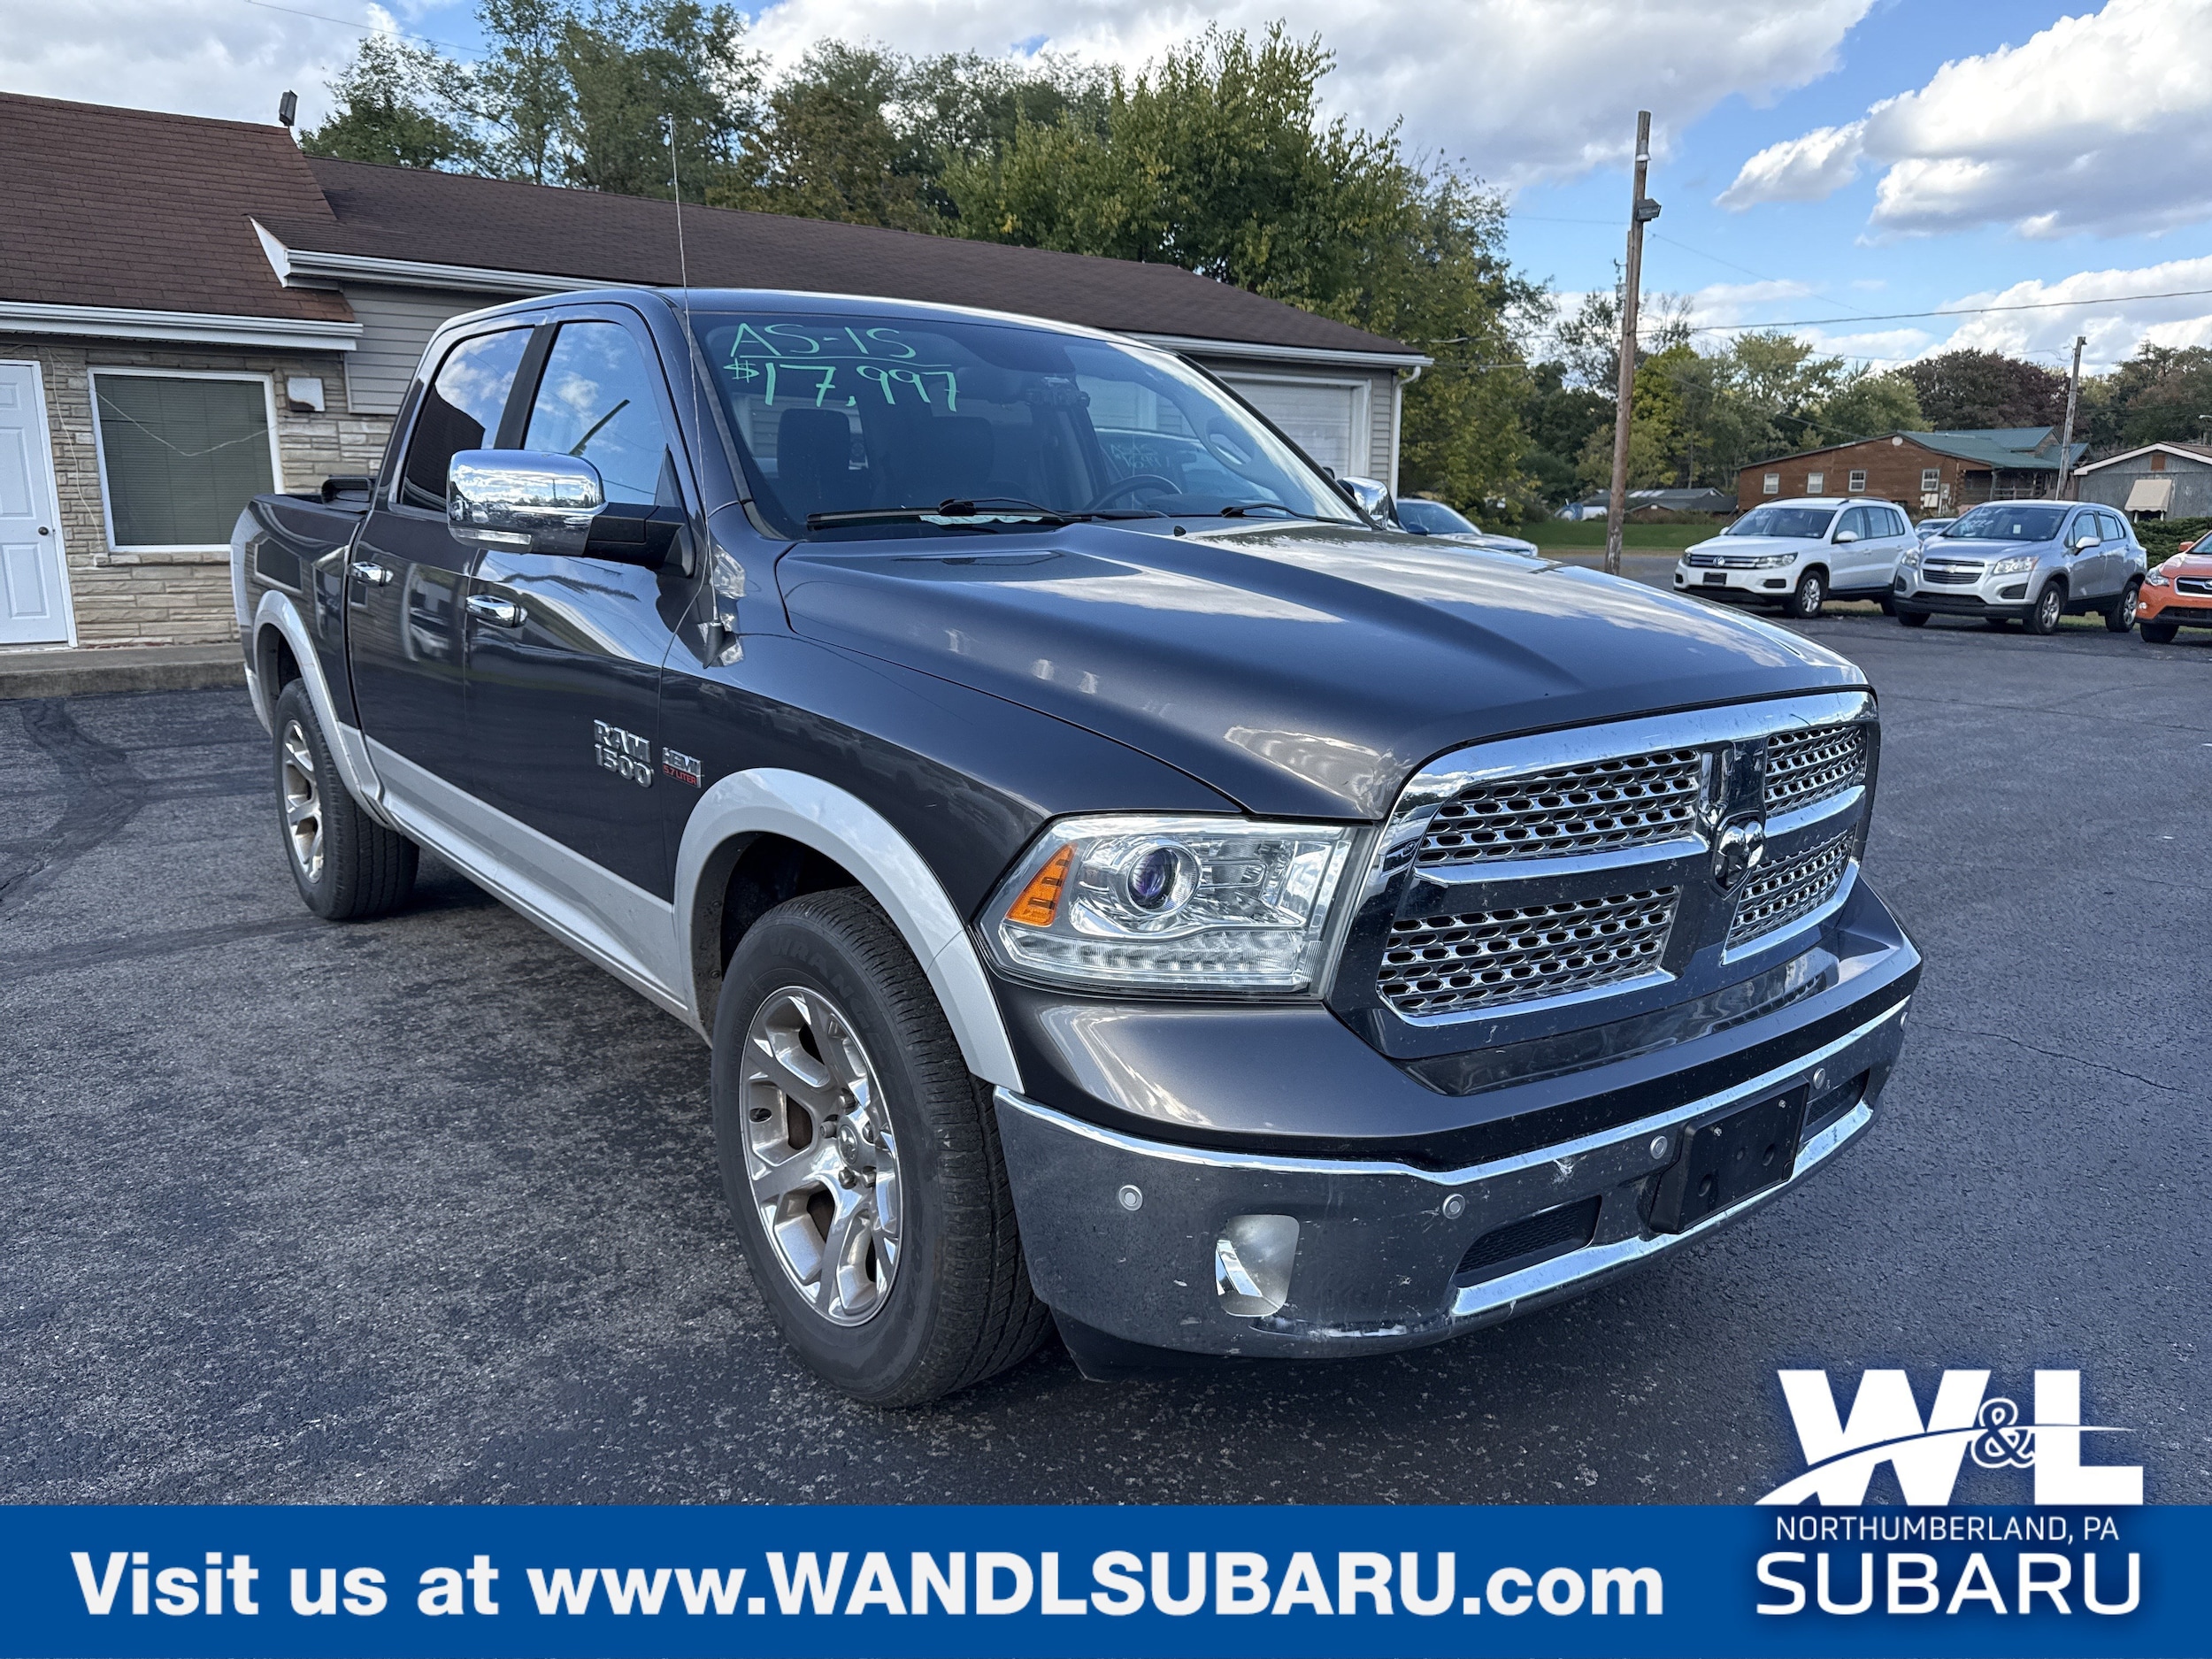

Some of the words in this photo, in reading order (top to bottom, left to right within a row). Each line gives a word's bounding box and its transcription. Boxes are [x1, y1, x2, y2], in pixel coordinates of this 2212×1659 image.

[730, 322, 917, 358] AS-IS
[723, 357, 960, 412] $17,997
[594, 718, 651, 764] RAM
[594, 743, 655, 788] 1500
[664, 764, 675, 776] 5.7
[675, 769, 697, 786] LITER
